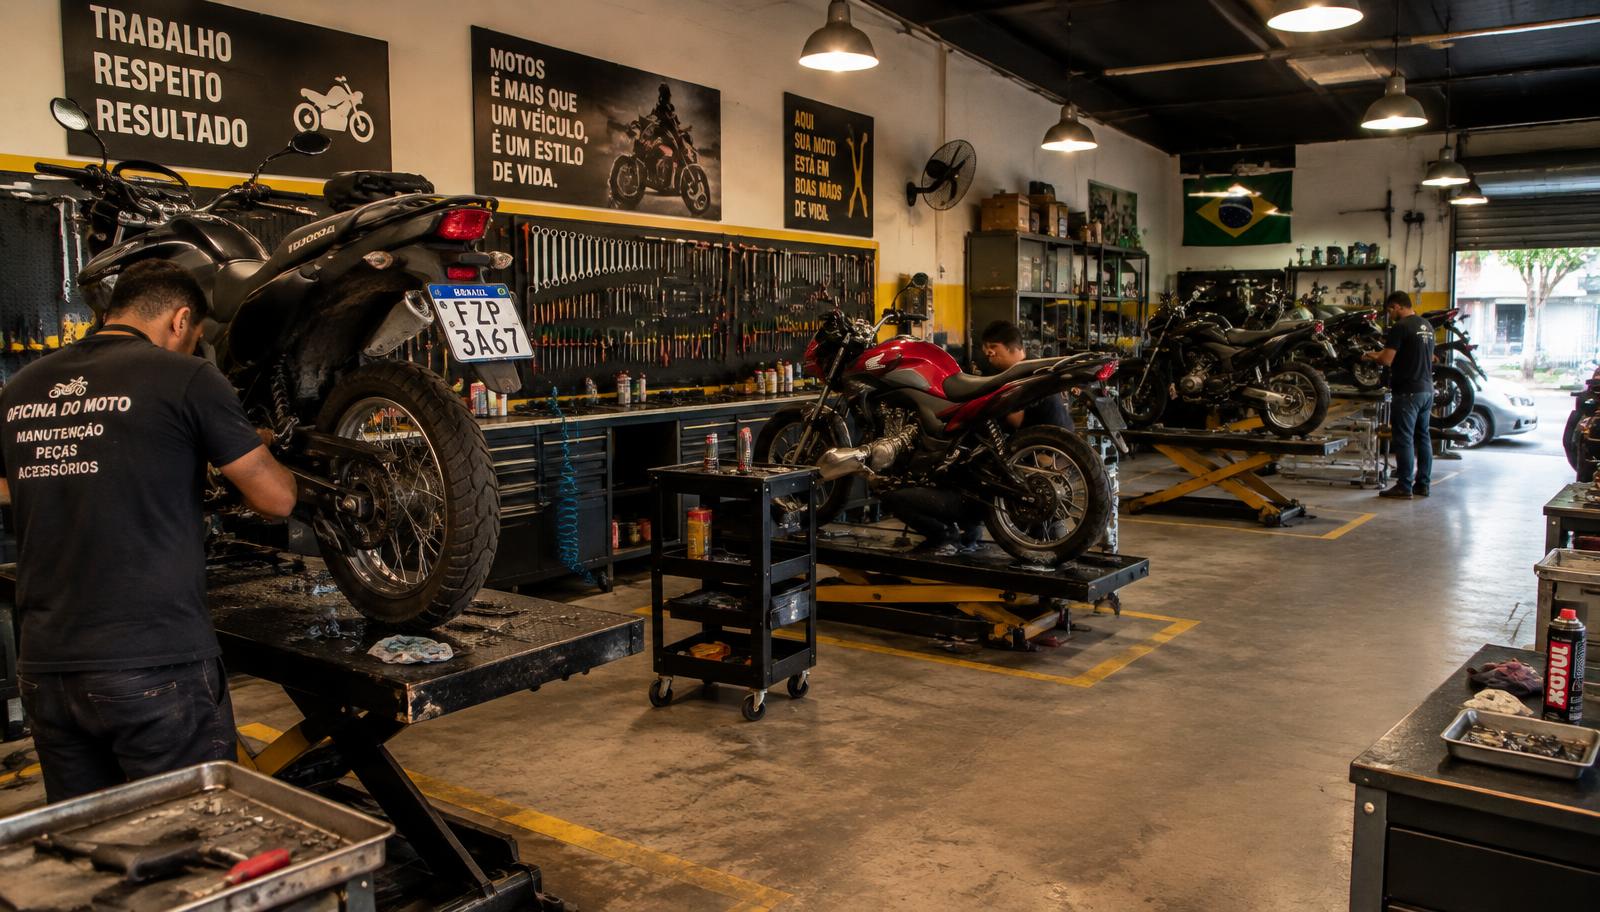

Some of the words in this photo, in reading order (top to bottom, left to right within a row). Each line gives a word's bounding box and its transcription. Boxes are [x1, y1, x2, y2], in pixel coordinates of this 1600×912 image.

[89, 4, 232, 63] TRABALHO
[93, 50, 222, 103] RESPEITO
[490, 47, 545, 80] MOTOS
[490, 70, 501, 98] É
[504, 78, 545, 107] MAIS
[548, 88, 578, 114] QUE
[95, 97, 248, 148] RESULTADO
[491, 103, 517, 129] UM
[794, 109, 814, 131] AQUI
[491, 128, 502, 154] É
[505, 134, 531, 158] UM
[534, 141, 584, 166] ESTILO
[794, 131, 810, 152] SUA
[813, 136, 837, 158] MOTO
[492, 160, 514, 183] DE
[516, 163, 558, 189] VIDA.
[794, 153, 814, 175] ESTÁ
[817, 159, 829, 178] EM
[794, 176, 817, 197] BOAS
[794, 199, 807, 219] DE
[453, 300, 501, 326] FZP
[455, 327, 521, 357] 3A67
[6, 402, 57, 423] OFICINA
[60, 400, 81, 417] DO
[83, 396, 132, 413] MOTO
[35, 443, 78, 460] PEÇAS
